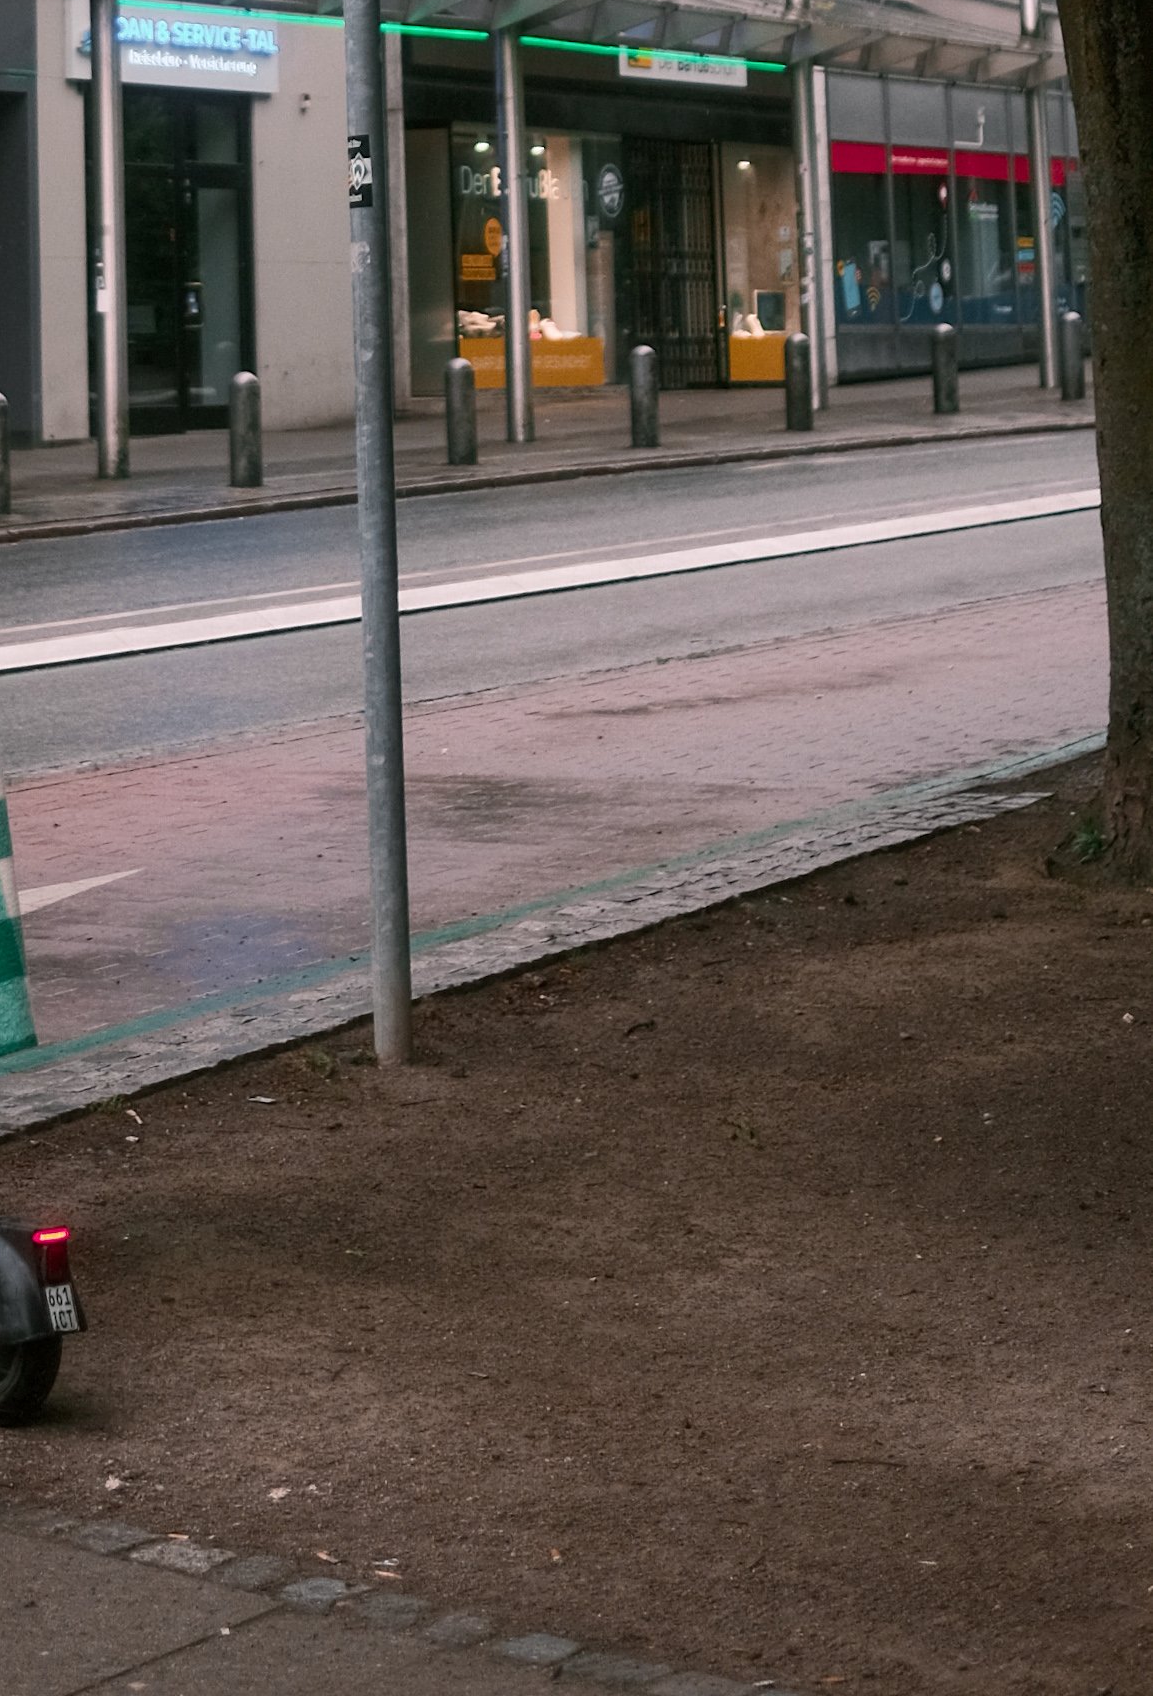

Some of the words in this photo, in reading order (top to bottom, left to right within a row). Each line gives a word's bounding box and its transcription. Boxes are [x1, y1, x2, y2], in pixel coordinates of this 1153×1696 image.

[156, 19, 171, 44] &
[460, 165, 491, 196] Der
[48, 1287, 71, 1307] 661
